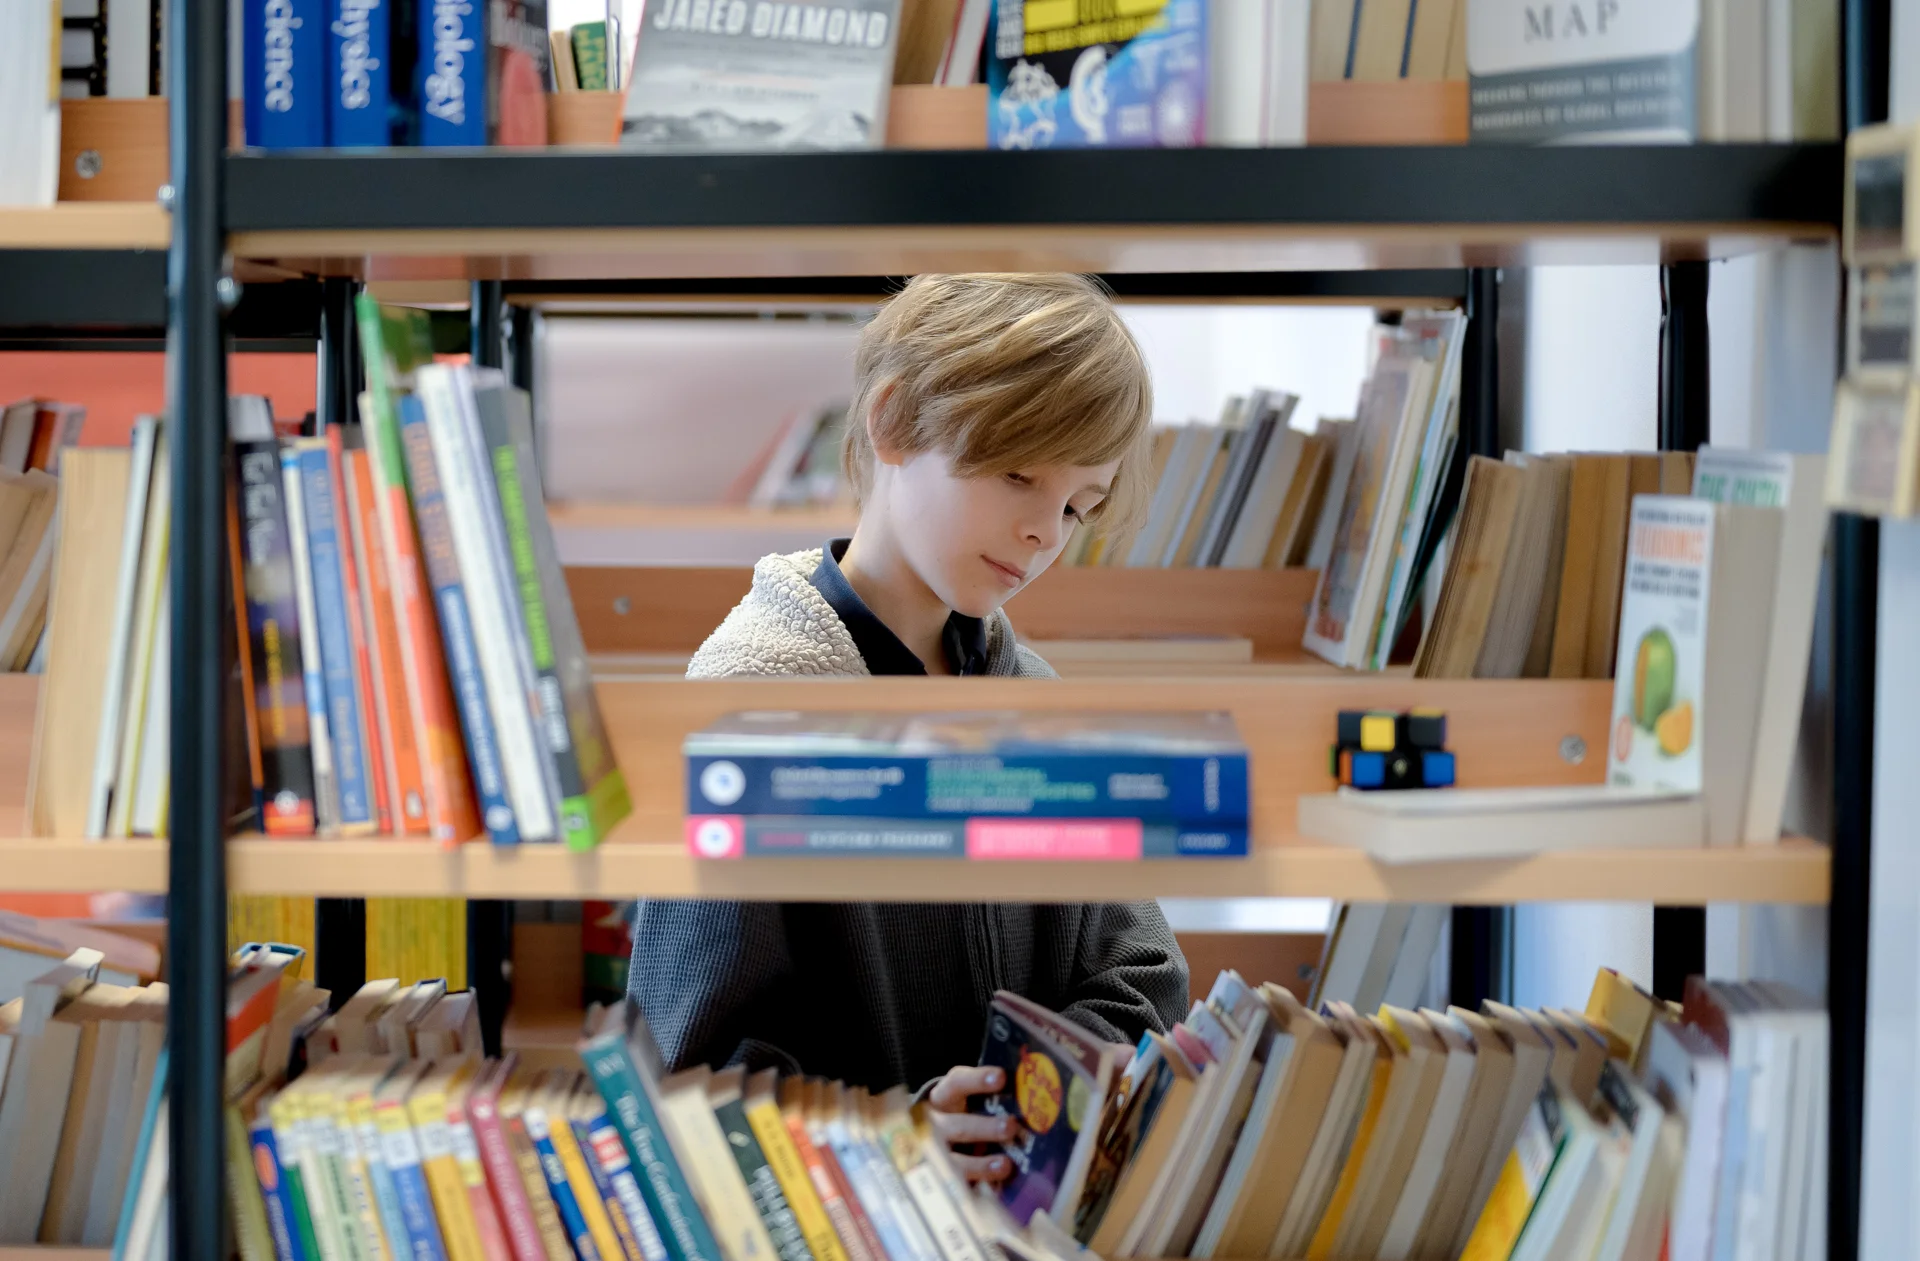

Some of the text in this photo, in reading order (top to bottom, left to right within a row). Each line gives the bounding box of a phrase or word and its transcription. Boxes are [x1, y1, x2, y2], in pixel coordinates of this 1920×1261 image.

[264, 0, 303, 113] cience
[331, 0, 380, 110] hysics
[425, 0, 475, 125] iology
[652, 0, 889, 49] JARED DIAMOND
[1524, 0, 1619, 43] MAP
[615, 1090, 640, 1124] The
[630, 1125, 653, 1163] True
